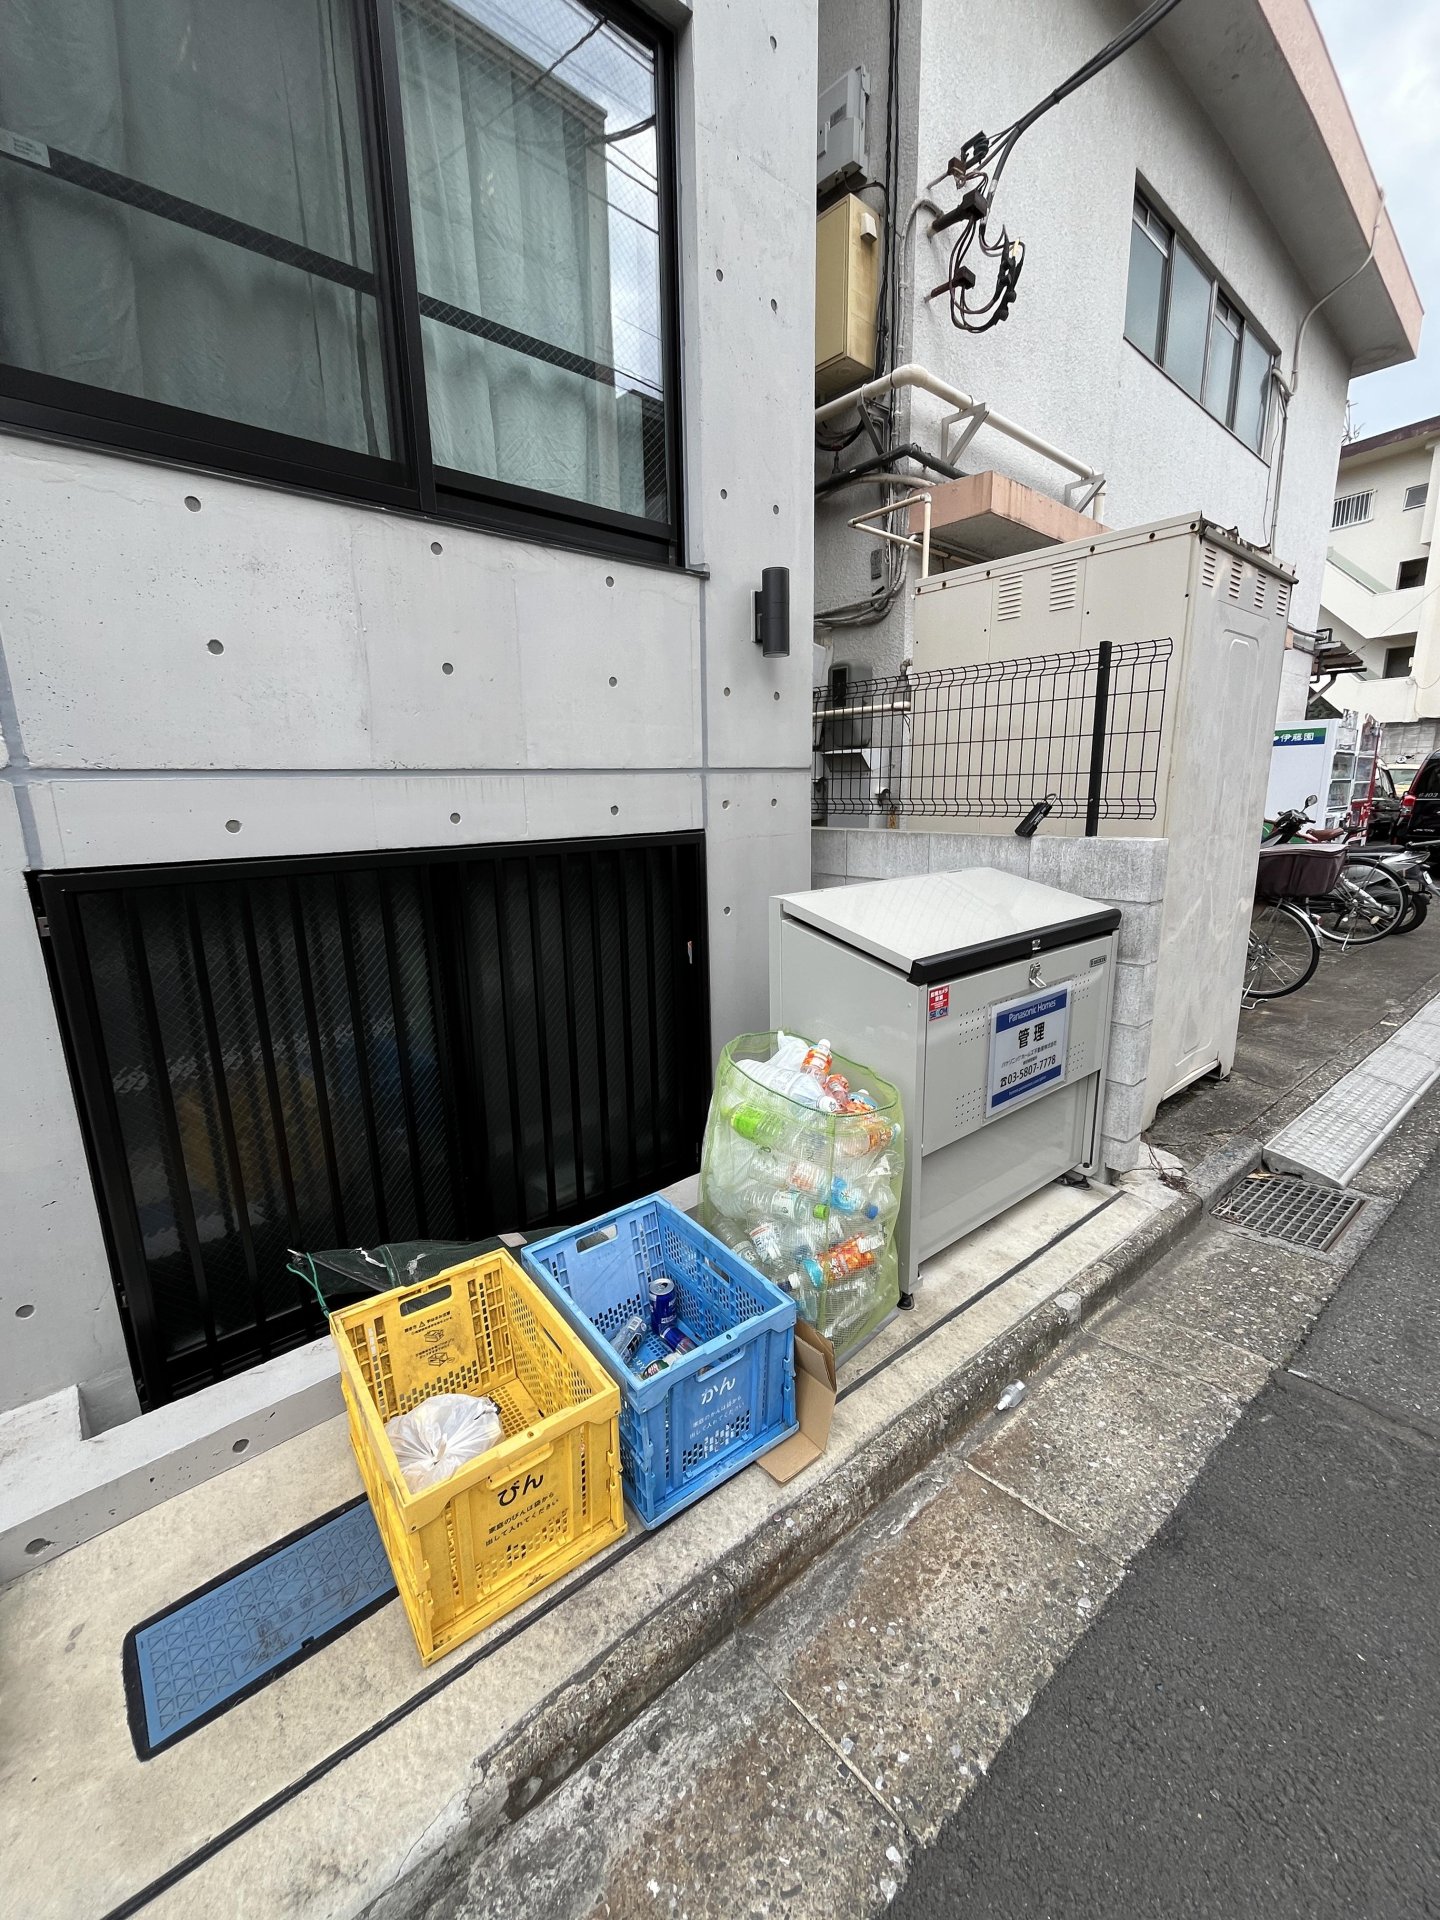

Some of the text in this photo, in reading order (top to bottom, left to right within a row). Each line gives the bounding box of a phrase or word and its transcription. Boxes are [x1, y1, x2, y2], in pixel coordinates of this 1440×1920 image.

[1008, 998, 1056, 1023] Panasonic Homes
[1018, 1021, 1046, 1049] 管理
[701, 1376, 736, 1405] かん
[497, 1474, 544, 1507] びん
